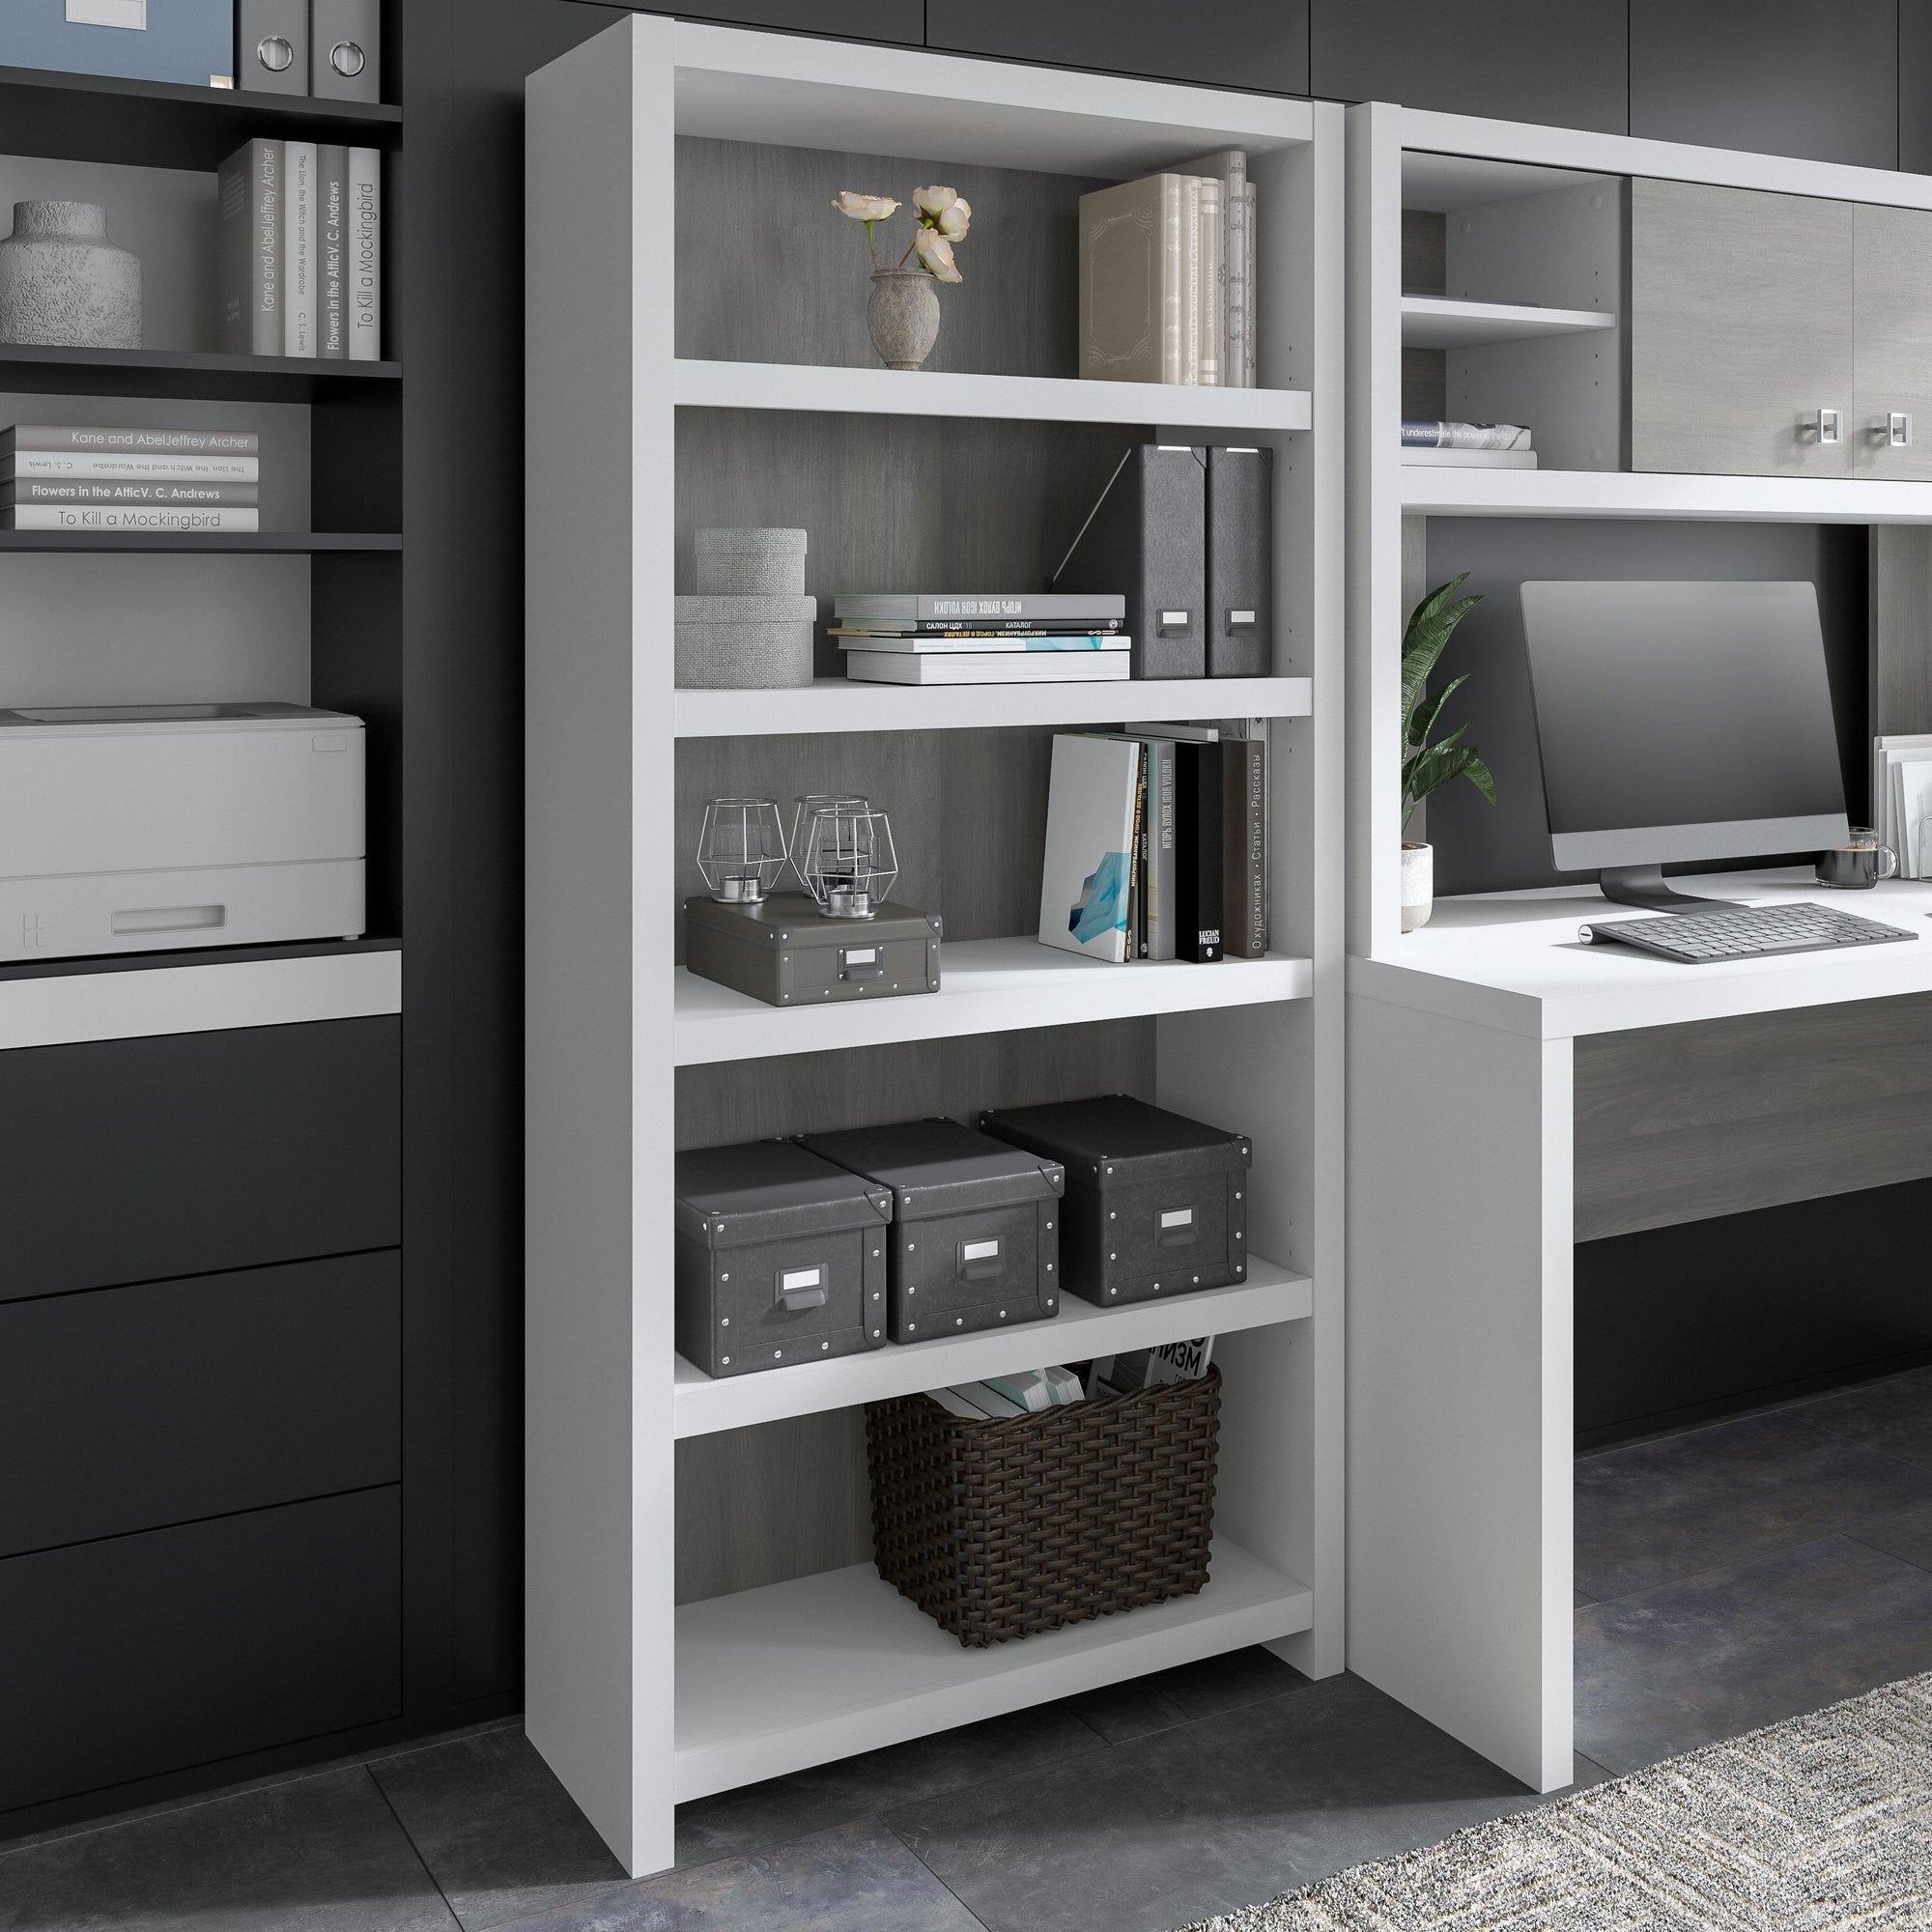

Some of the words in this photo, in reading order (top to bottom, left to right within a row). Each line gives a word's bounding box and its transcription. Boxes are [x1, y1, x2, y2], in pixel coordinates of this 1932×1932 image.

[262, 148, 274, 186] Archer
[328, 182, 339, 226] Andrews
[328, 230, 339, 241] C.
[357, 184, 377, 272] Mockingbird
[261, 256, 274, 279] and
[327, 281, 339, 297] the
[360, 278, 373, 287] a
[261, 283, 274, 311] Kane
[327, 300, 339, 309] in
[357, 291, 373, 308] Kill
[357, 313, 373, 327] To
[327, 313, 339, 350] Flowers
[71, 432, 104, 444] Kane
[108, 433, 133, 445] and
[210, 437, 248, 448] Archer
[1406, 428, 1450, 439] underestimate
[32, 485, 75, 497] Flowers
[78, 486, 88, 497] in
[92, 486, 110, 497] the
[156, 489, 167, 498] C.
[171, 488, 219, 499] Andrews
[59, 511, 76, 526] To
[82, 512, 100, 526] Kill
[106, 515, 117, 526] a
[123, 512, 220, 529] Mockingbird
[935, 601, 959, 614] VULOKH
[961, 601, 977, 614] IGOR
[980, 601, 1000, 614] ВУЛОХ
[1002, 601, 1021, 614] ИГОРЬ
[949, 622, 962, 631] ЦДХ
[1162, 759, 1172, 785] VULOKH
[1251, 754, 1261, 808] Рассказы
[1162, 787, 1172, 803] IGOR
[1162, 805, 1172, 826] ВУЛОХ
[1162, 828, 1172, 849] ИГОРЬ
[1252, 822, 1261, 860] Статьи
[1253, 874, 1264, 939] художниках
